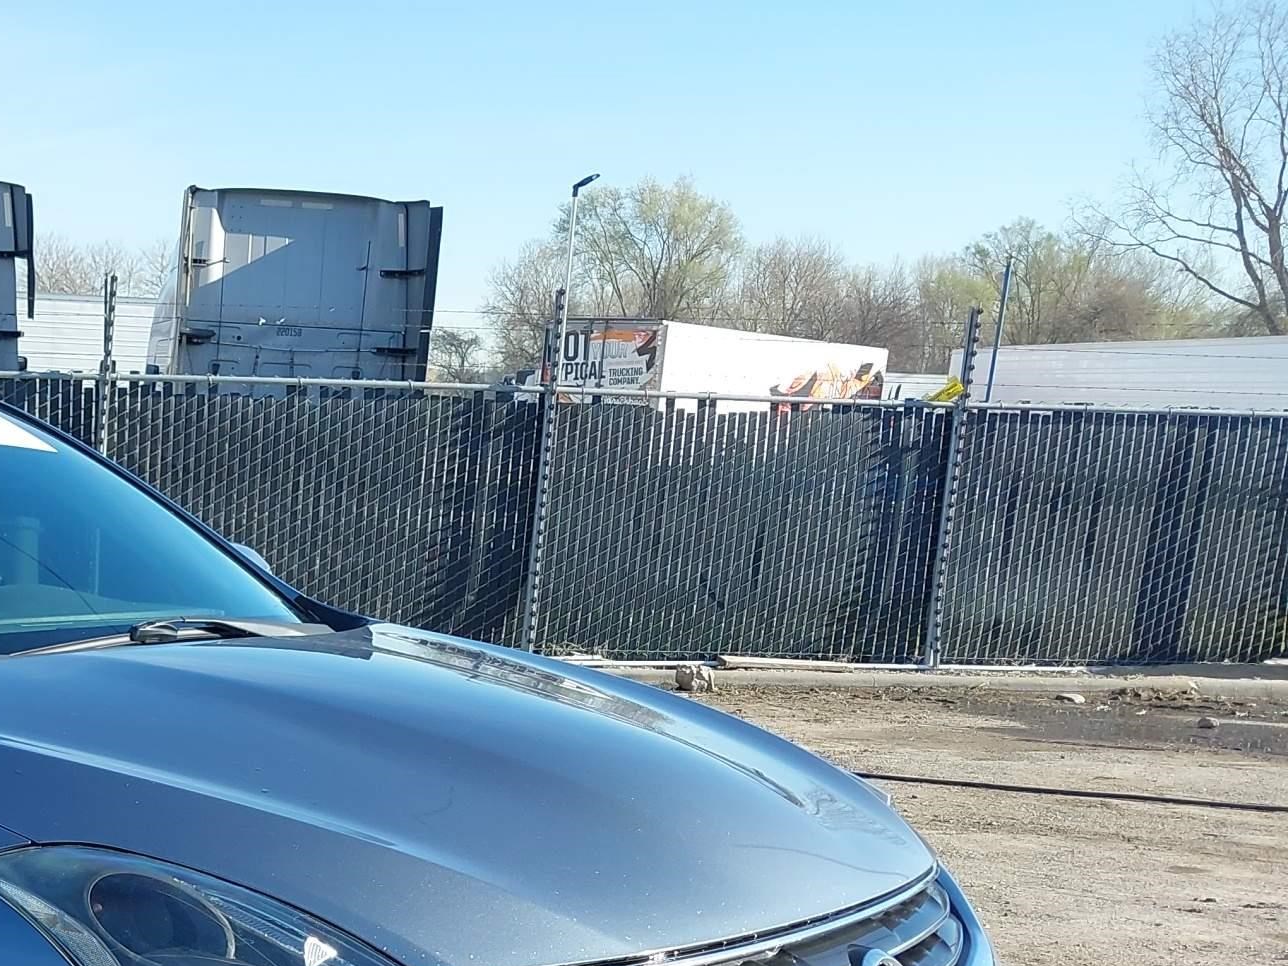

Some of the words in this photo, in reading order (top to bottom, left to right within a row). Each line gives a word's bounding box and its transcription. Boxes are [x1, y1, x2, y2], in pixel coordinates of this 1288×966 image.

[564, 330, 593, 361] OT
[609, 367, 643, 377] TRUCKING
[609, 377, 640, 386] COMPANY.
